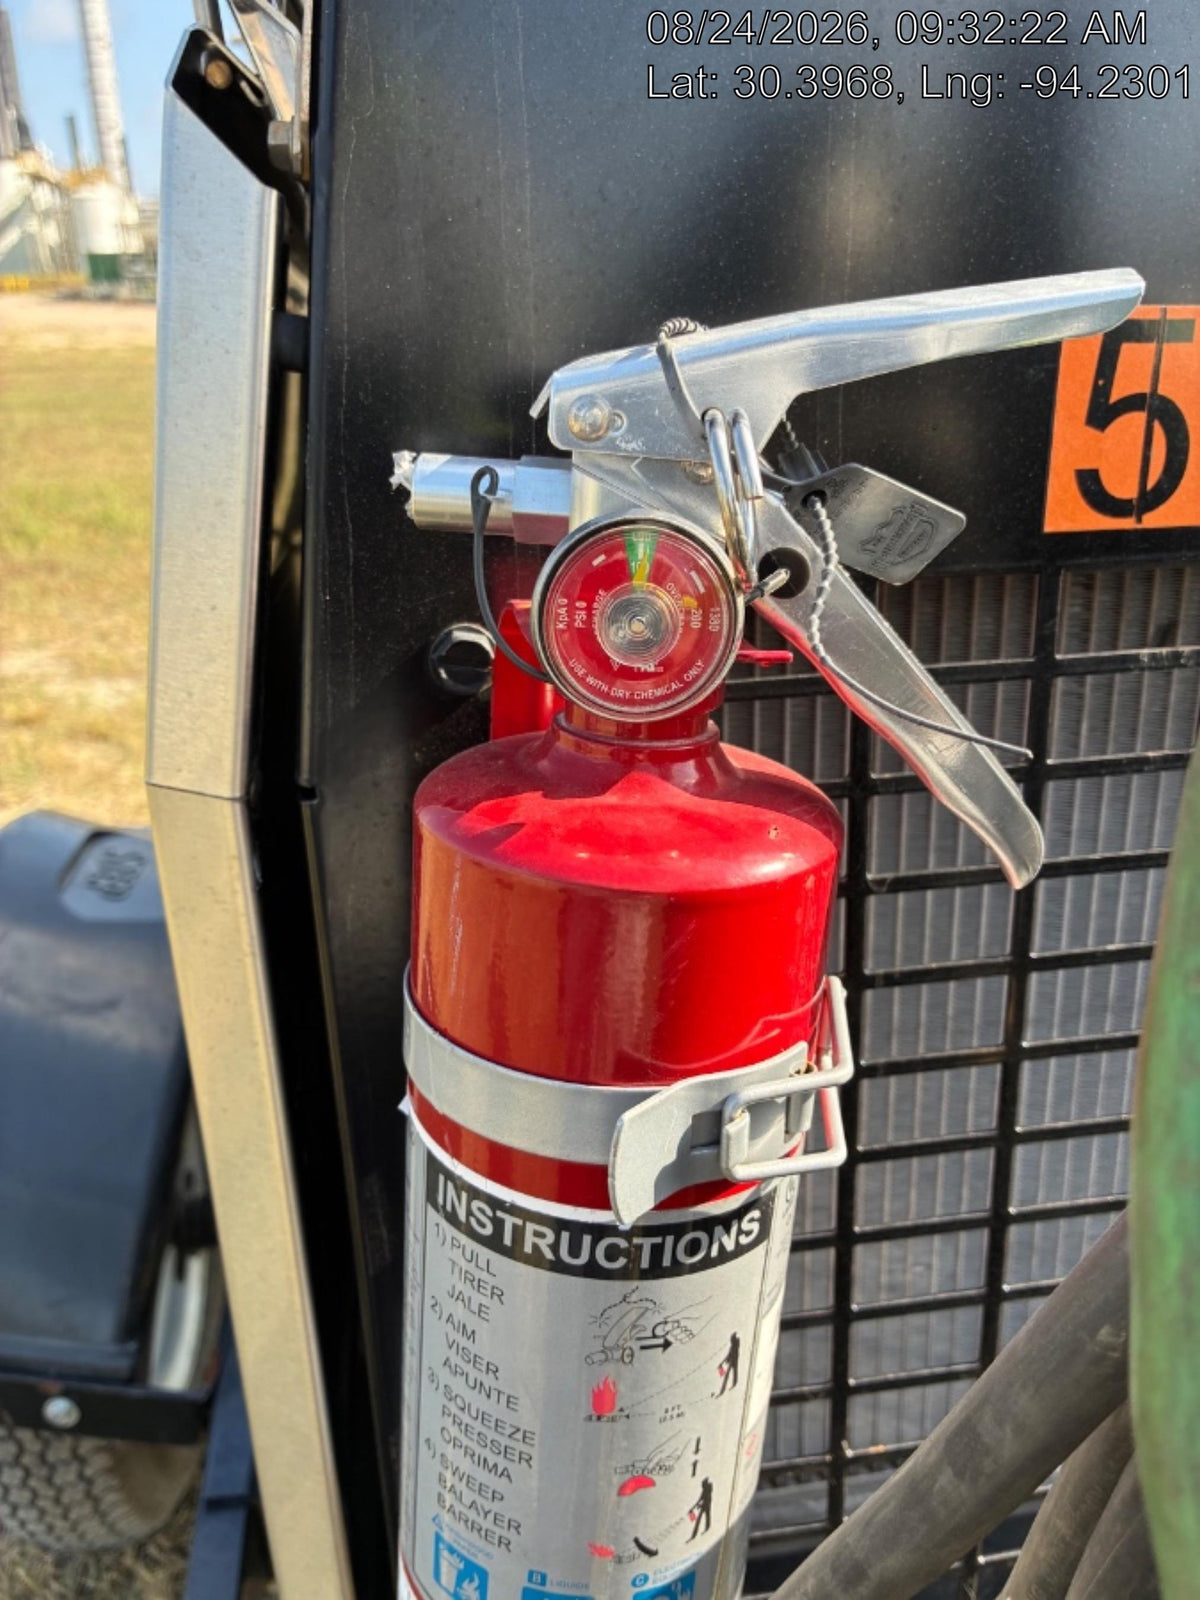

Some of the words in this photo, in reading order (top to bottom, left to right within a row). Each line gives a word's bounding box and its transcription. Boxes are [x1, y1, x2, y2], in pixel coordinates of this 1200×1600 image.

[574, 610, 587, 629] PSI
[575, 600, 588, 609] 0
[568, 658, 587, 678] USE
[586, 674, 609, 693] WITH
[610, 687, 631, 699] DRY
[633, 680, 684, 700] CHEMICAL
[683, 659, 705, 682] ONLY
[437, 1172, 762, 1270] INSTRUCTIONS
[434, 1222, 447, 1247] 1)
[450, 1236, 497, 1278] PULL
[447, 1284, 491, 1322] JALE
[448, 1257, 504, 1306] TIRER
[430, 1295, 443, 1321] 2)
[445, 1312, 476, 1345] AIM
[445, 1331, 500, 1381] VISER
[442, 1356, 520, 1413] APUNTE
[441, 1403, 533, 1469] PRESSER
[443, 1384, 537, 1448] SQUEEZE
[439, 1451, 505, 1503] SWEEP
[440, 1426, 513, 1485] OPRIMA
[436, 1491, 512, 1554] BARRER
[438, 1471, 522, 1536] BALAYER
